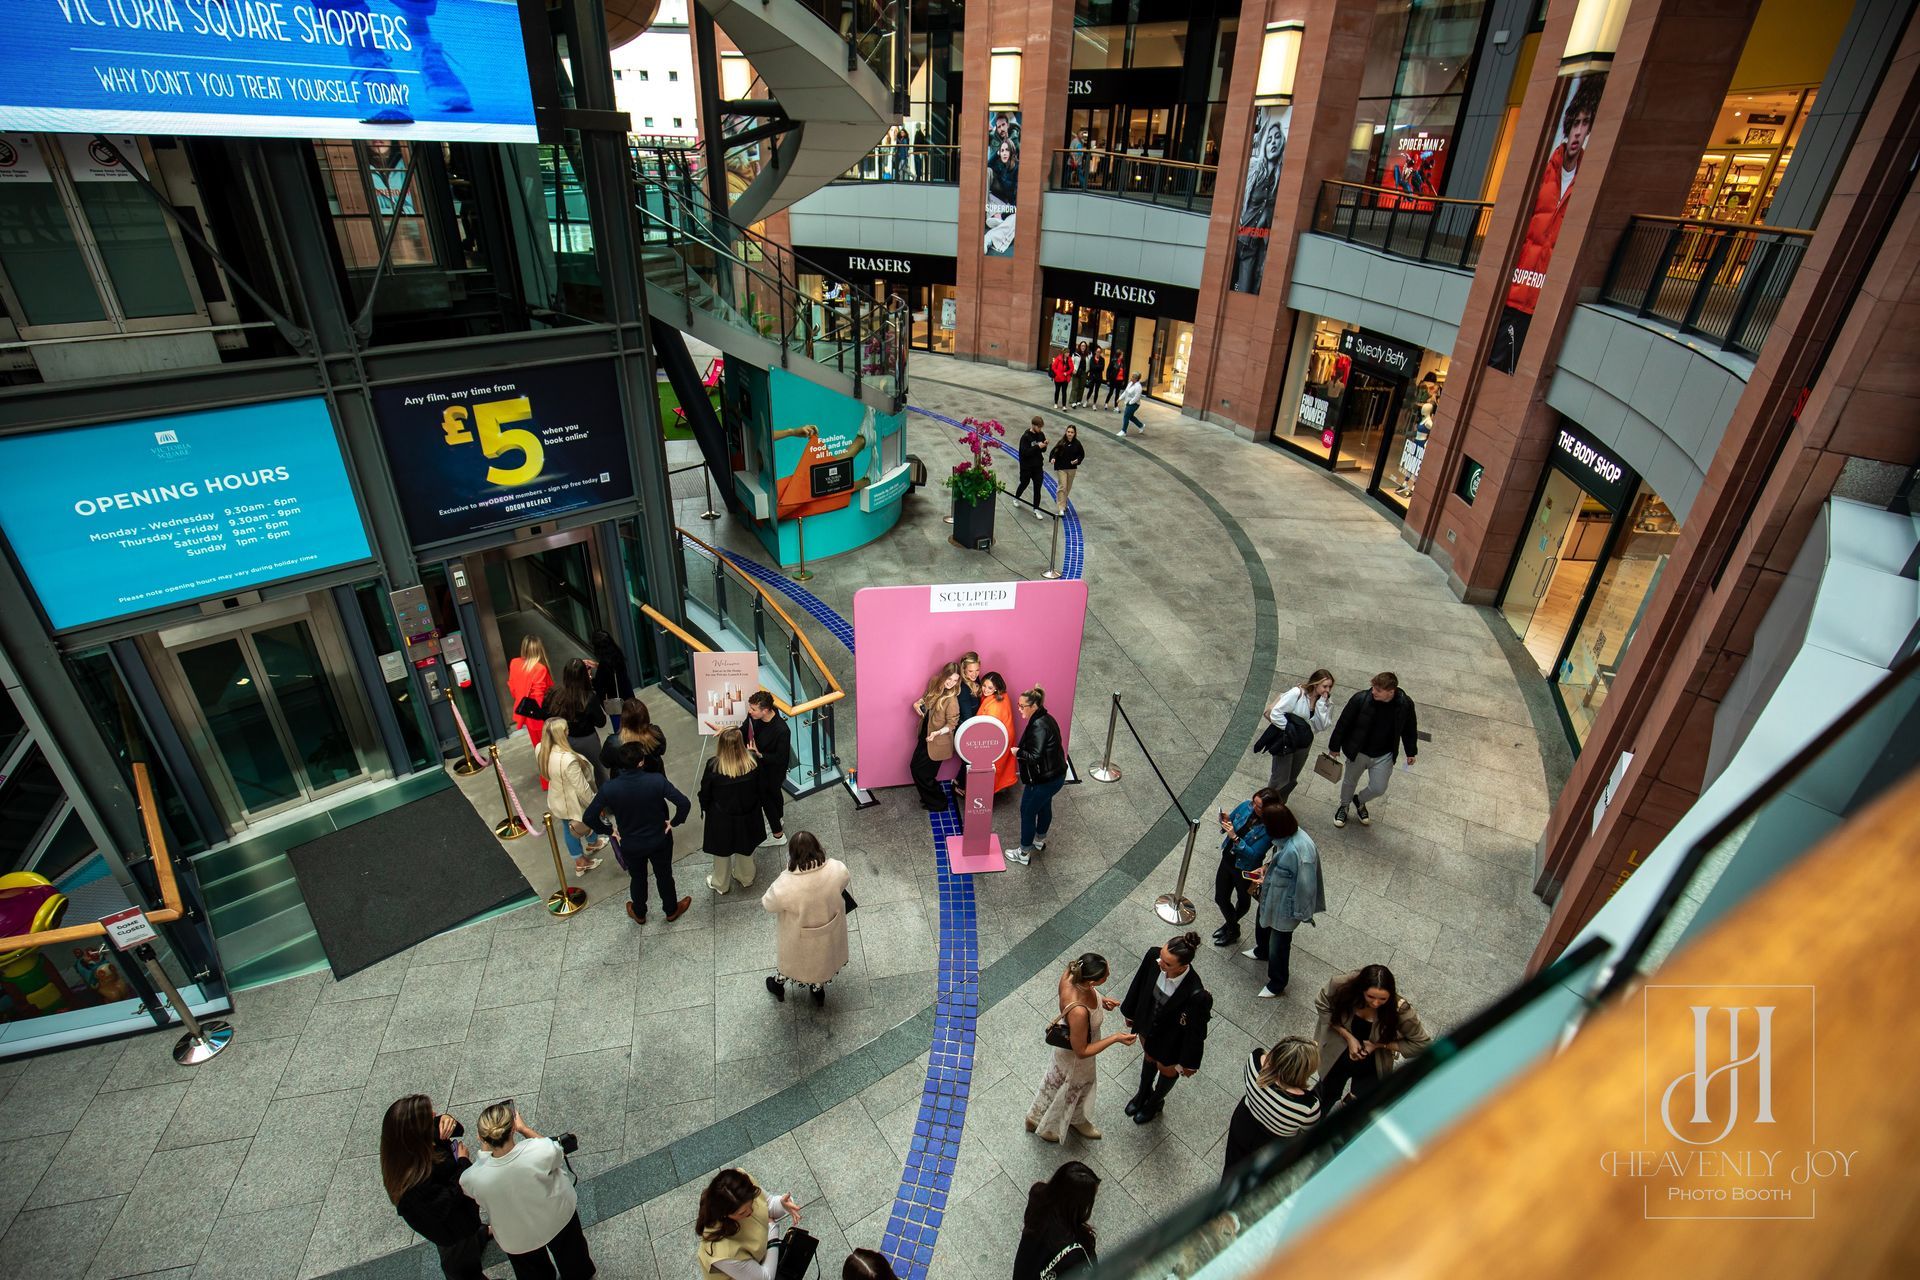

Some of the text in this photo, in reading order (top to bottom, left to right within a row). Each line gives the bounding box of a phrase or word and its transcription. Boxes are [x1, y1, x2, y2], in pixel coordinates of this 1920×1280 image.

[57, 0, 413, 51] VICTORIA SQUARE SHOPPERS
[94, 66, 410, 106] WHY DON'T YOU TREAT YOURSELF TODAY?
[1398, 138, 1446, 151] SPIDER-MAN 2
[848, 256, 911, 273] FRASERS
[1093, 281, 1156, 305] FRASERS
[1355, 338, 1408, 371] Sweaty Betty
[404, 383, 515, 406] Any film, any time from
[1299, 404, 1327, 426] POWER
[542, 423, 579, 435] when you
[817, 433, 846, 444] Fashion,
[151, 443, 192, 455] VICTORIA
[543, 435, 564, 446] book
[809, 445, 827, 453] food
[827, 442, 841, 450] and
[157, 449, 190, 459] SQUARE
[815, 451, 825, 459] all
[1558, 430, 1622, 484] THE BODY SHOP
[74, 466, 290, 517] OPENING HOURS
[438, 505, 469, 516] Exclusive
[478, 494, 515, 508] myODEON
[515, 489, 543, 499] members
[547, 485, 561, 493] sign
[582, 477, 598, 486] today
[505, 497, 552, 513] ODEON BELFAST
[89, 527, 138, 542] Monday
[148, 512, 215, 530] Wednesday
[224, 502, 265, 516] 9.30am
[273, 496, 298, 507] 6pm
[119, 532, 173, 548] Thursday
[183, 523, 219, 536] Friday
[228, 513, 269, 527] 9.30am
[277, 507, 301, 517] 9pm
[173, 533, 223, 549] Saturday
[232, 527, 256, 537] 9am
[265, 520, 289, 530] 6pm
[186, 543, 227, 557] Sunday
[236, 536, 258, 546] 1pm
[267, 530, 291, 540] 6pm
[118, 592, 144, 603] Please
[145, 589, 163, 598] note
[164, 582, 195, 593] opening
[196, 577, 217, 586] hours
[250, 564, 273, 574] during
[274, 558, 298, 568] holiday
[299, 554, 318, 562] times
[939, 590, 1008, 602] SCULPTED
[116, 920, 139, 930] DOME
[117, 924, 146, 936] CLOSED
